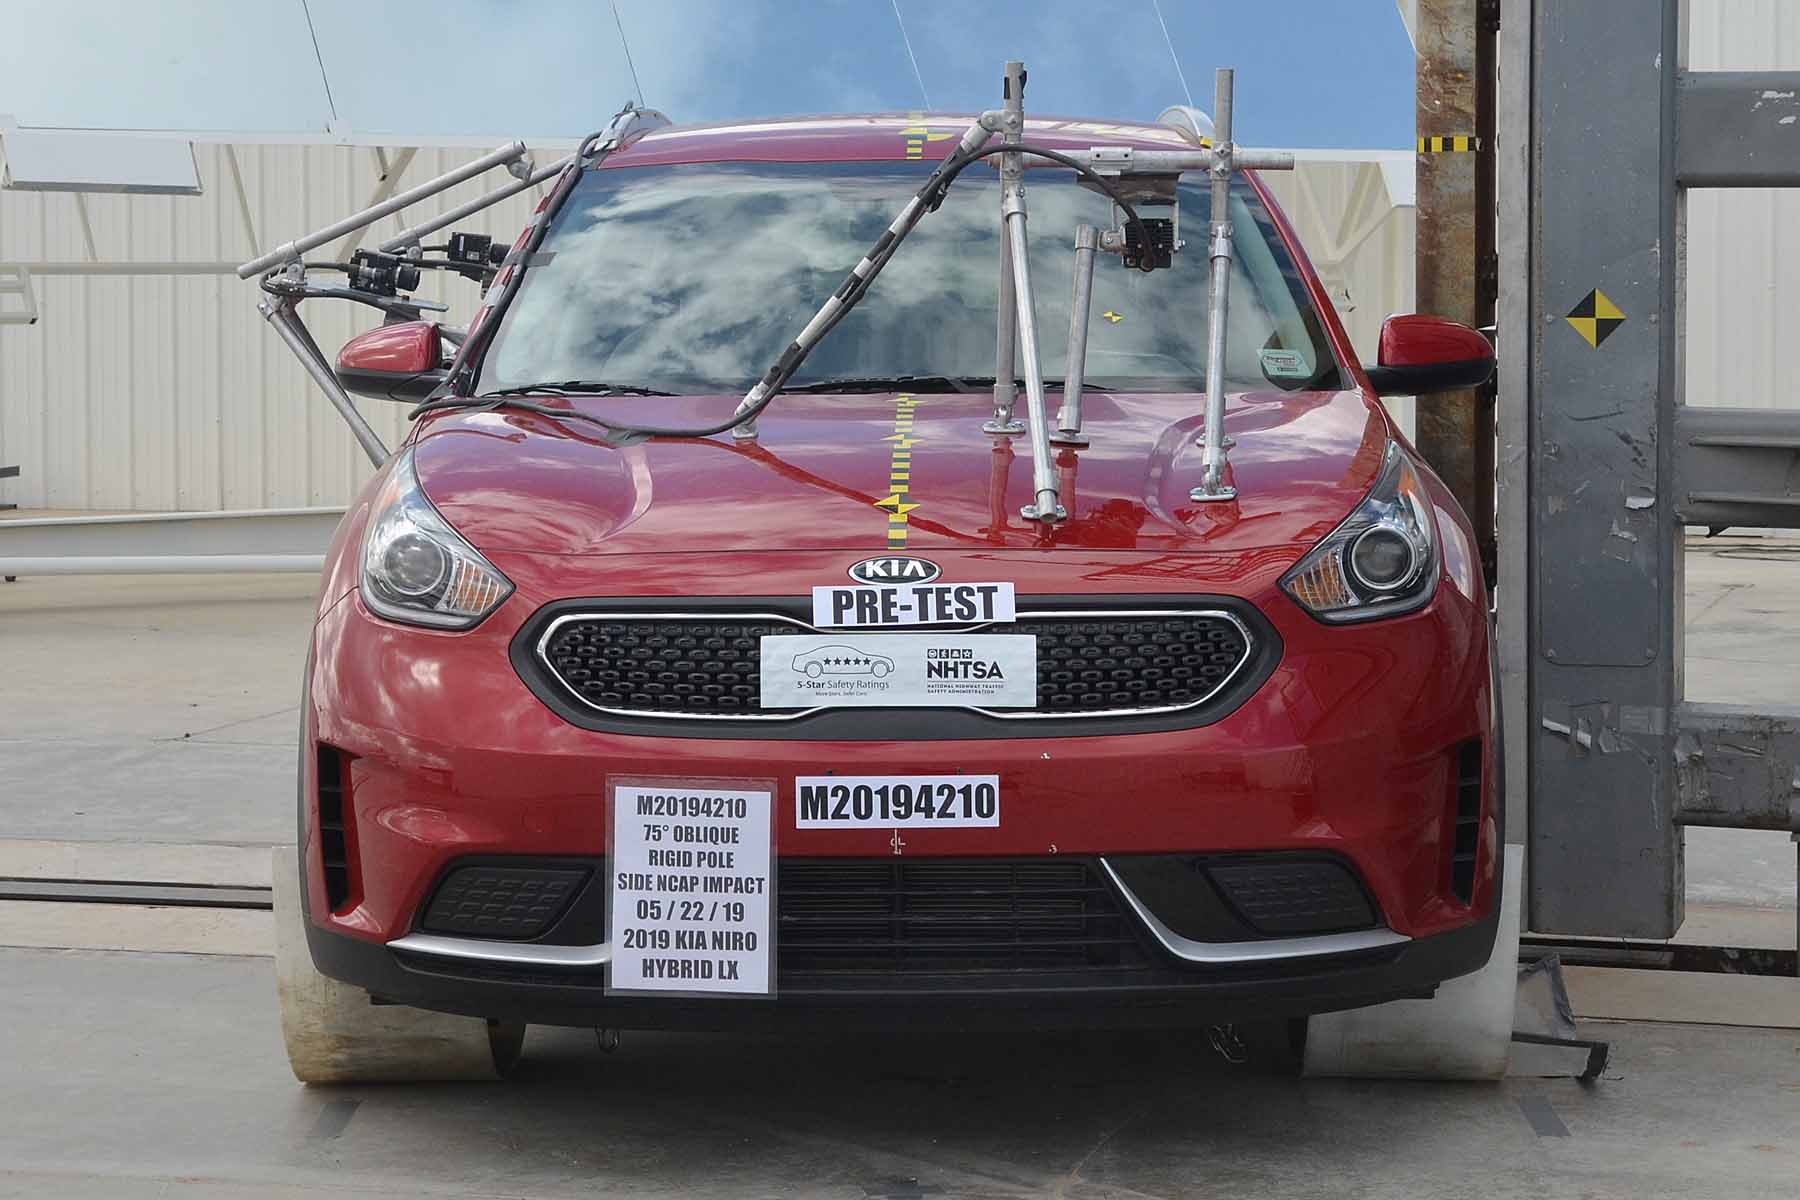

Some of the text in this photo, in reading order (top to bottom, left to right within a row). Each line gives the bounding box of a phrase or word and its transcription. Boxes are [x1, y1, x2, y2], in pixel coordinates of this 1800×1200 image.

[865, 559, 927, 578] KIA
[832, 586, 998, 625] PRE-TEST
[927, 661, 1004, 679] NHTSA
[797, 680, 890, 691] 5-Star Safety Ratings
[636, 795, 747, 818] M20194210
[800, 783, 996, 820] M20194210
[643, 824, 740, 845] 75° OBLIQUE
[648, 849, 734, 868] RIGID POLE
[618, 872, 765, 894] SIDE NCAP IMPACT
[637, 899, 662, 920] 05
[680, 901, 704, 921] 22
[722, 902, 745, 922] 19
[623, 928, 757, 951] 2019 KIA NIRO
[642, 958, 739, 980] HYBRID LX
